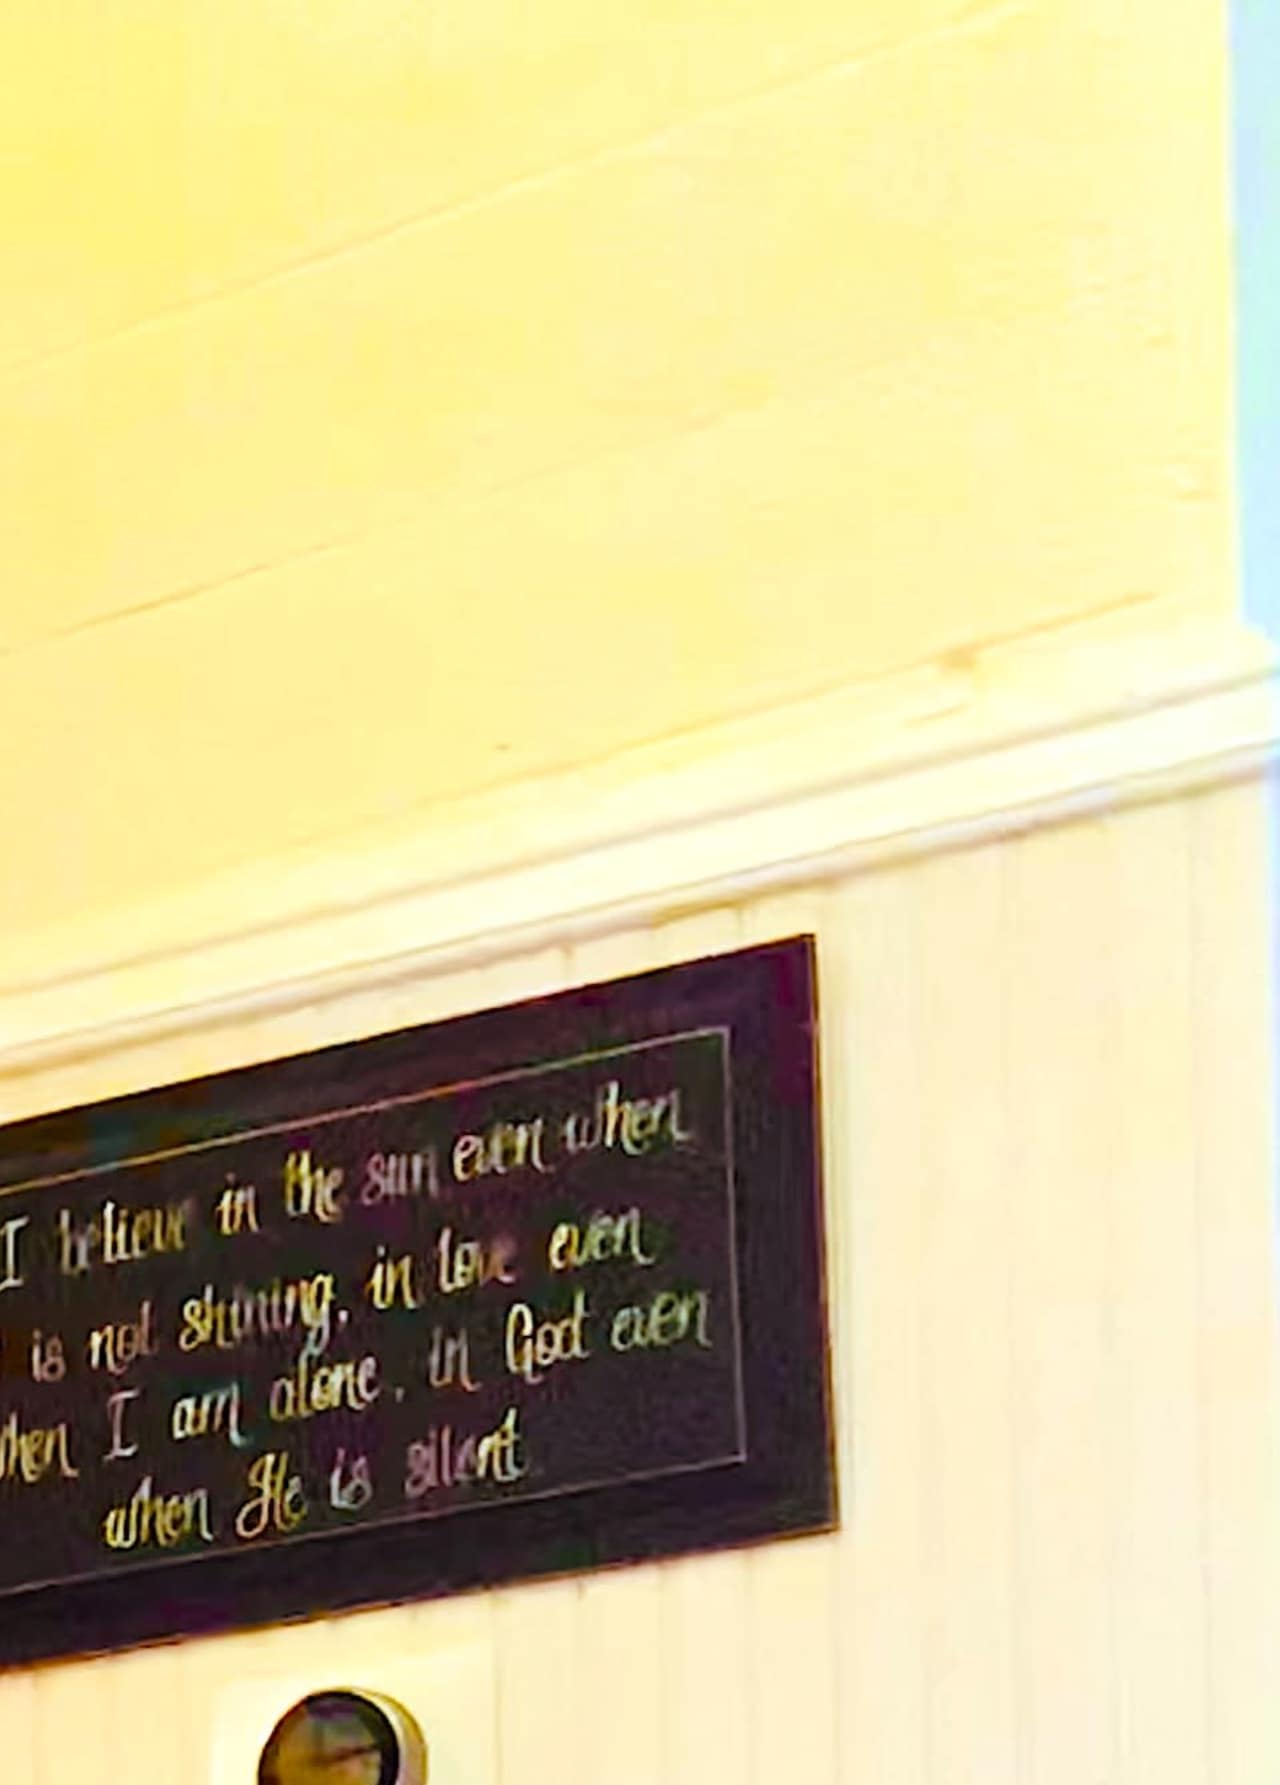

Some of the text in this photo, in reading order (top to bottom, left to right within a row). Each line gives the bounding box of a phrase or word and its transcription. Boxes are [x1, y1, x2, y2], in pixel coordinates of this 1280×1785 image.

[216, 1172, 262, 1236] in
[285, 1148, 344, 1223] the
[360, 1150, 440, 1207] sun
[452, 1118, 556, 1183] even
[564, 1080, 698, 1155] when
[32, 1328, 67, 1383] is
[367, 1244, 417, 1311] in
[438, 1227, 518, 1294] love
[548, 1207, 658, 1272] even
[102, 1388, 140, 1463] I
[171, 1382, 256, 1448] am
[428, 1326, 482, 1392] in
[504, 1288, 592, 1386] God
[608, 1288, 714, 1353] even
[102, 1406, 526, 1550] when He is silent
